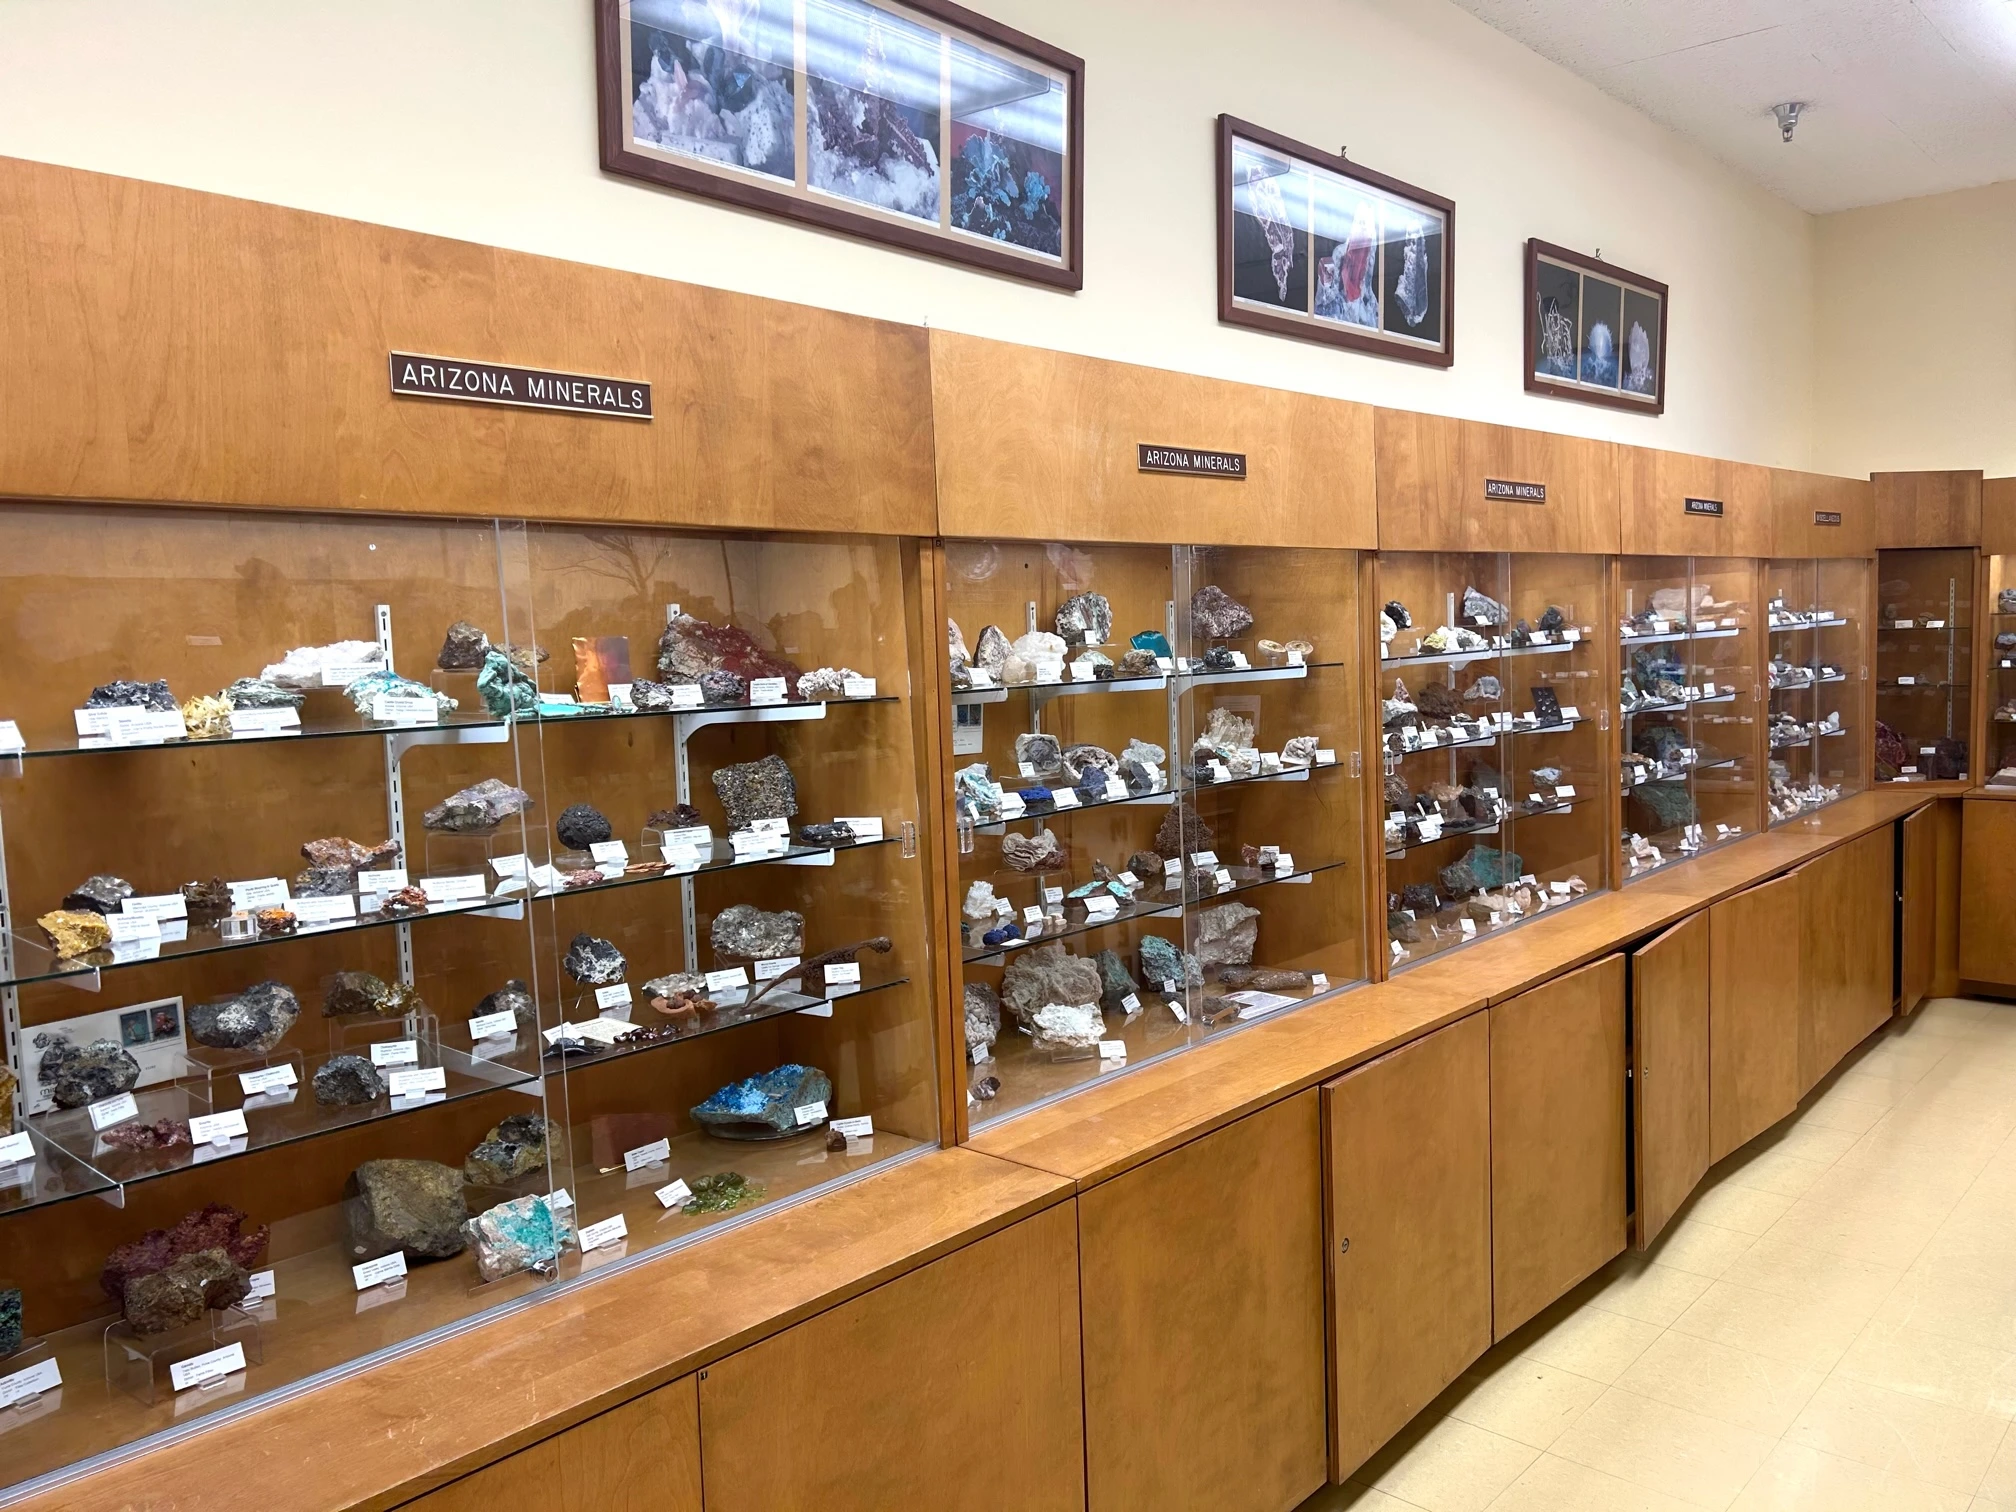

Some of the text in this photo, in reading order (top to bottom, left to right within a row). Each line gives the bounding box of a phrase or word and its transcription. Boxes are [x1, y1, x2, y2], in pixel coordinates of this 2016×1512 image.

[402, 363, 643, 410] ARIZONA MINERALS
[1146, 450, 1240, 472] ARIZONA MINERALS
[1487, 483, 1545, 498] ARIZONA MINERALS
